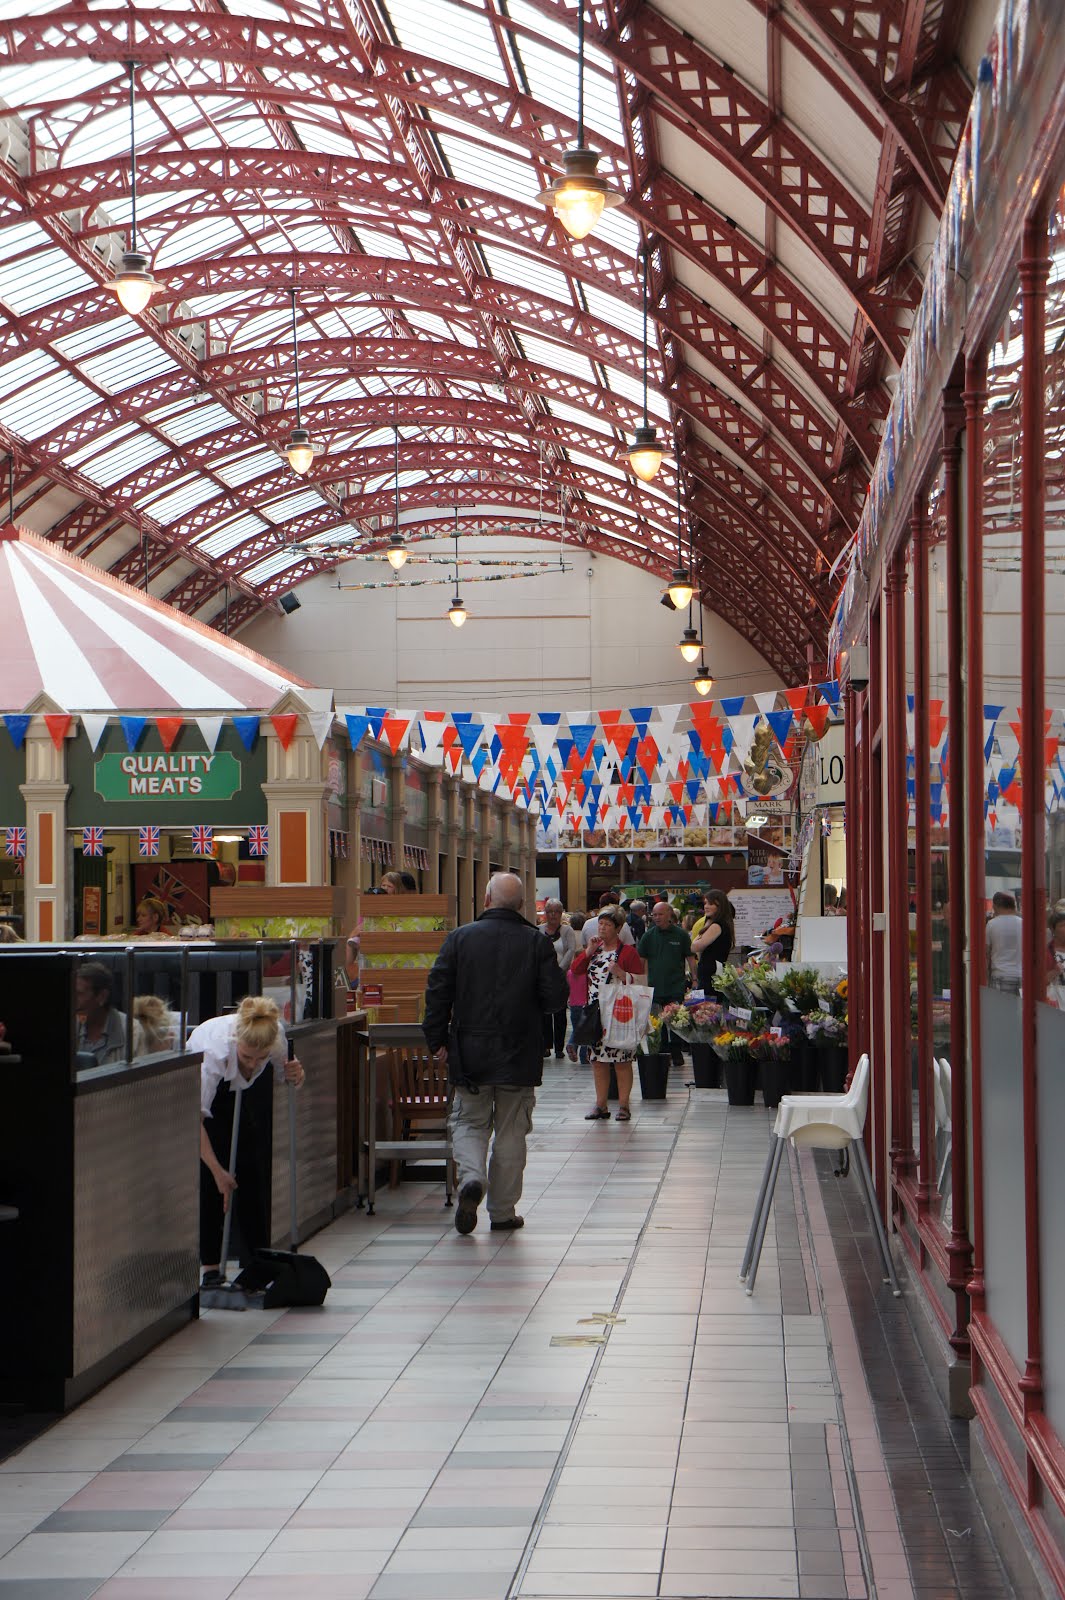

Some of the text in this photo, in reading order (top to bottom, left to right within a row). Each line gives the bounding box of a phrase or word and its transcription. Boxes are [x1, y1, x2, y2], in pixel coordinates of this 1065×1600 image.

[120, 755, 216, 776] QUALITY
[820, 755, 846, 786] LO
[128, 776, 203, 795] MEATS
[754, 800, 782, 808] MARK
[665, 888, 702, 897] WILSON
